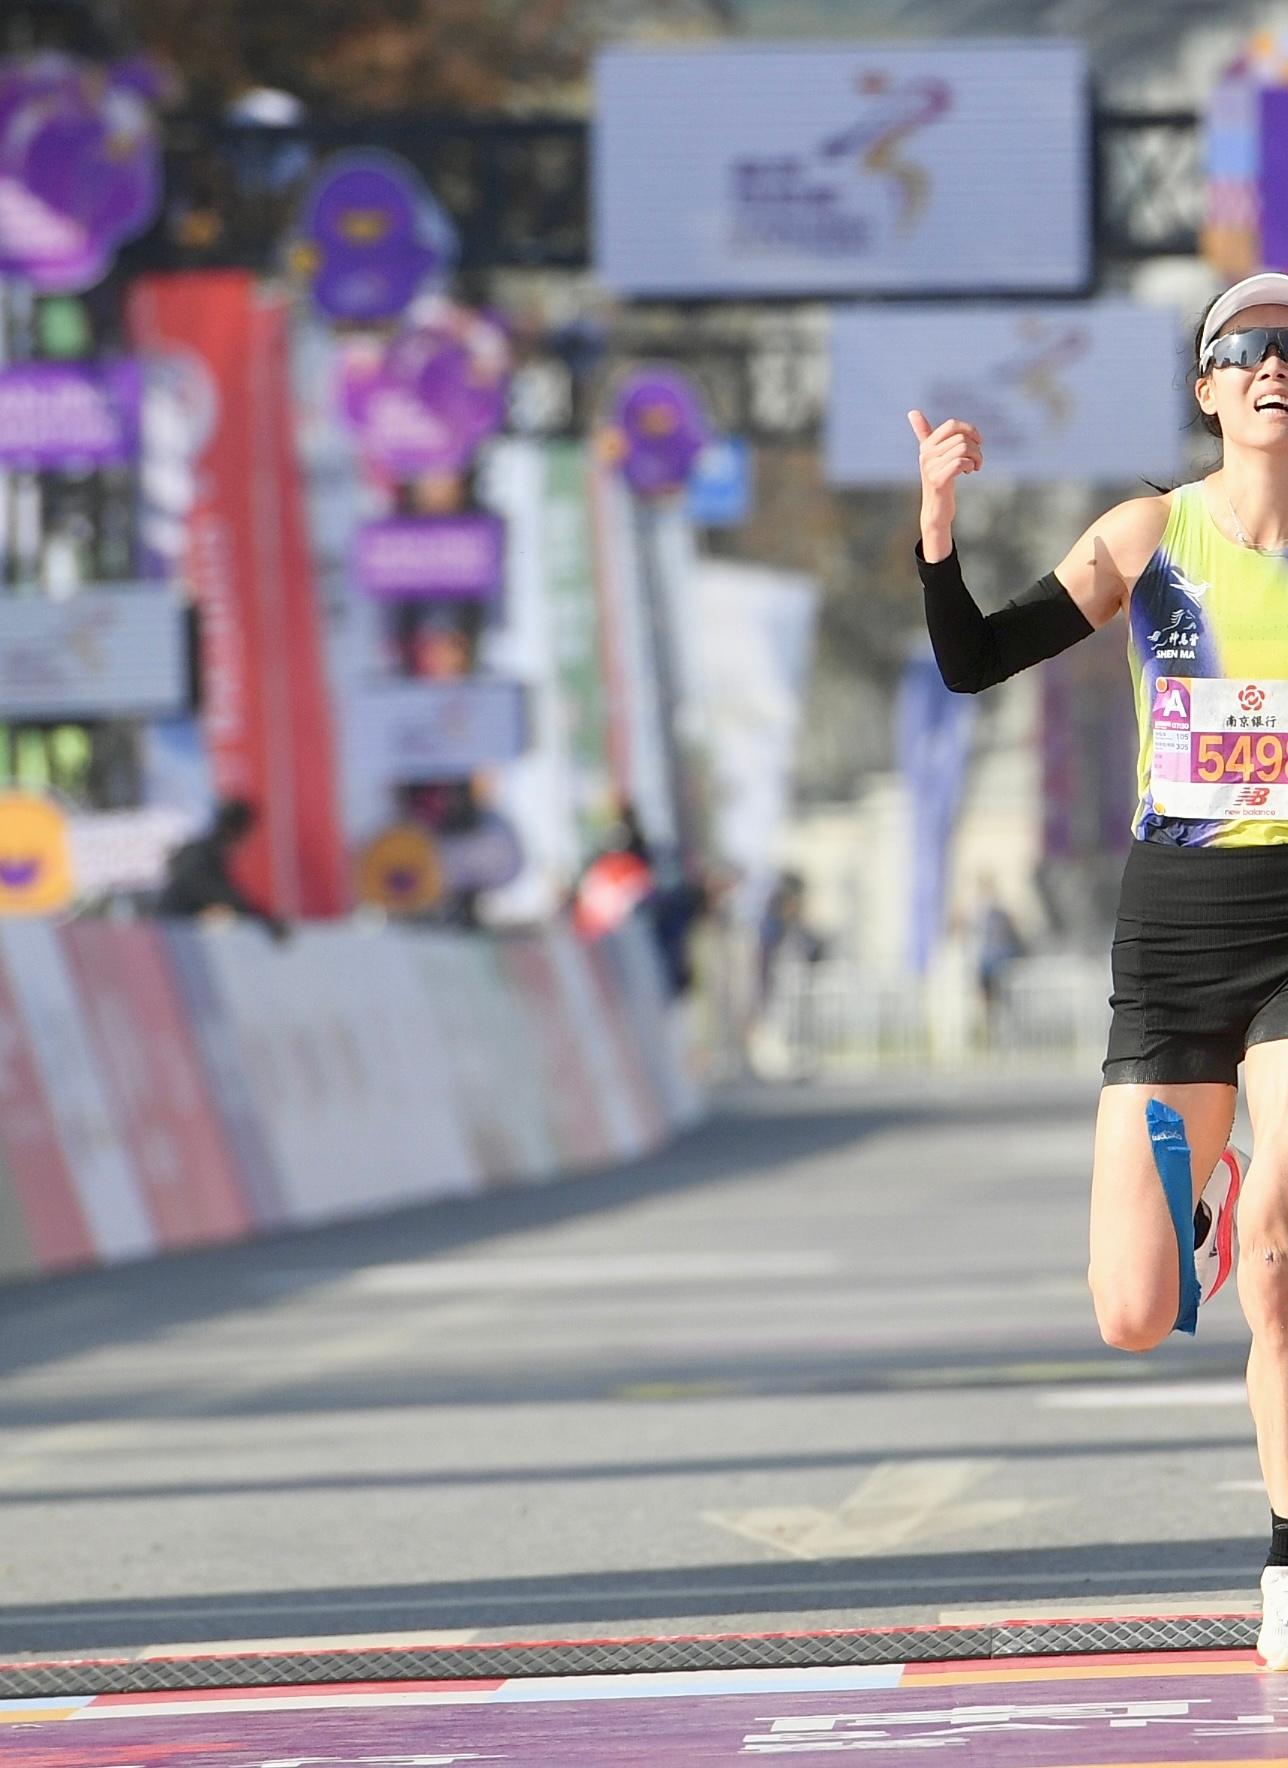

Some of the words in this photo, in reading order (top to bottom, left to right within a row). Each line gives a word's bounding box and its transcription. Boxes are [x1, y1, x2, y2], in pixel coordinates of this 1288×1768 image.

[1156, 649, 1178, 659] SHEN
[1179, 649, 1195, 659] MA
[1163, 689, 1187, 718] A
[1226, 714, 1277, 728] 南京银行
[1243, 807, 1276, 816] balance
